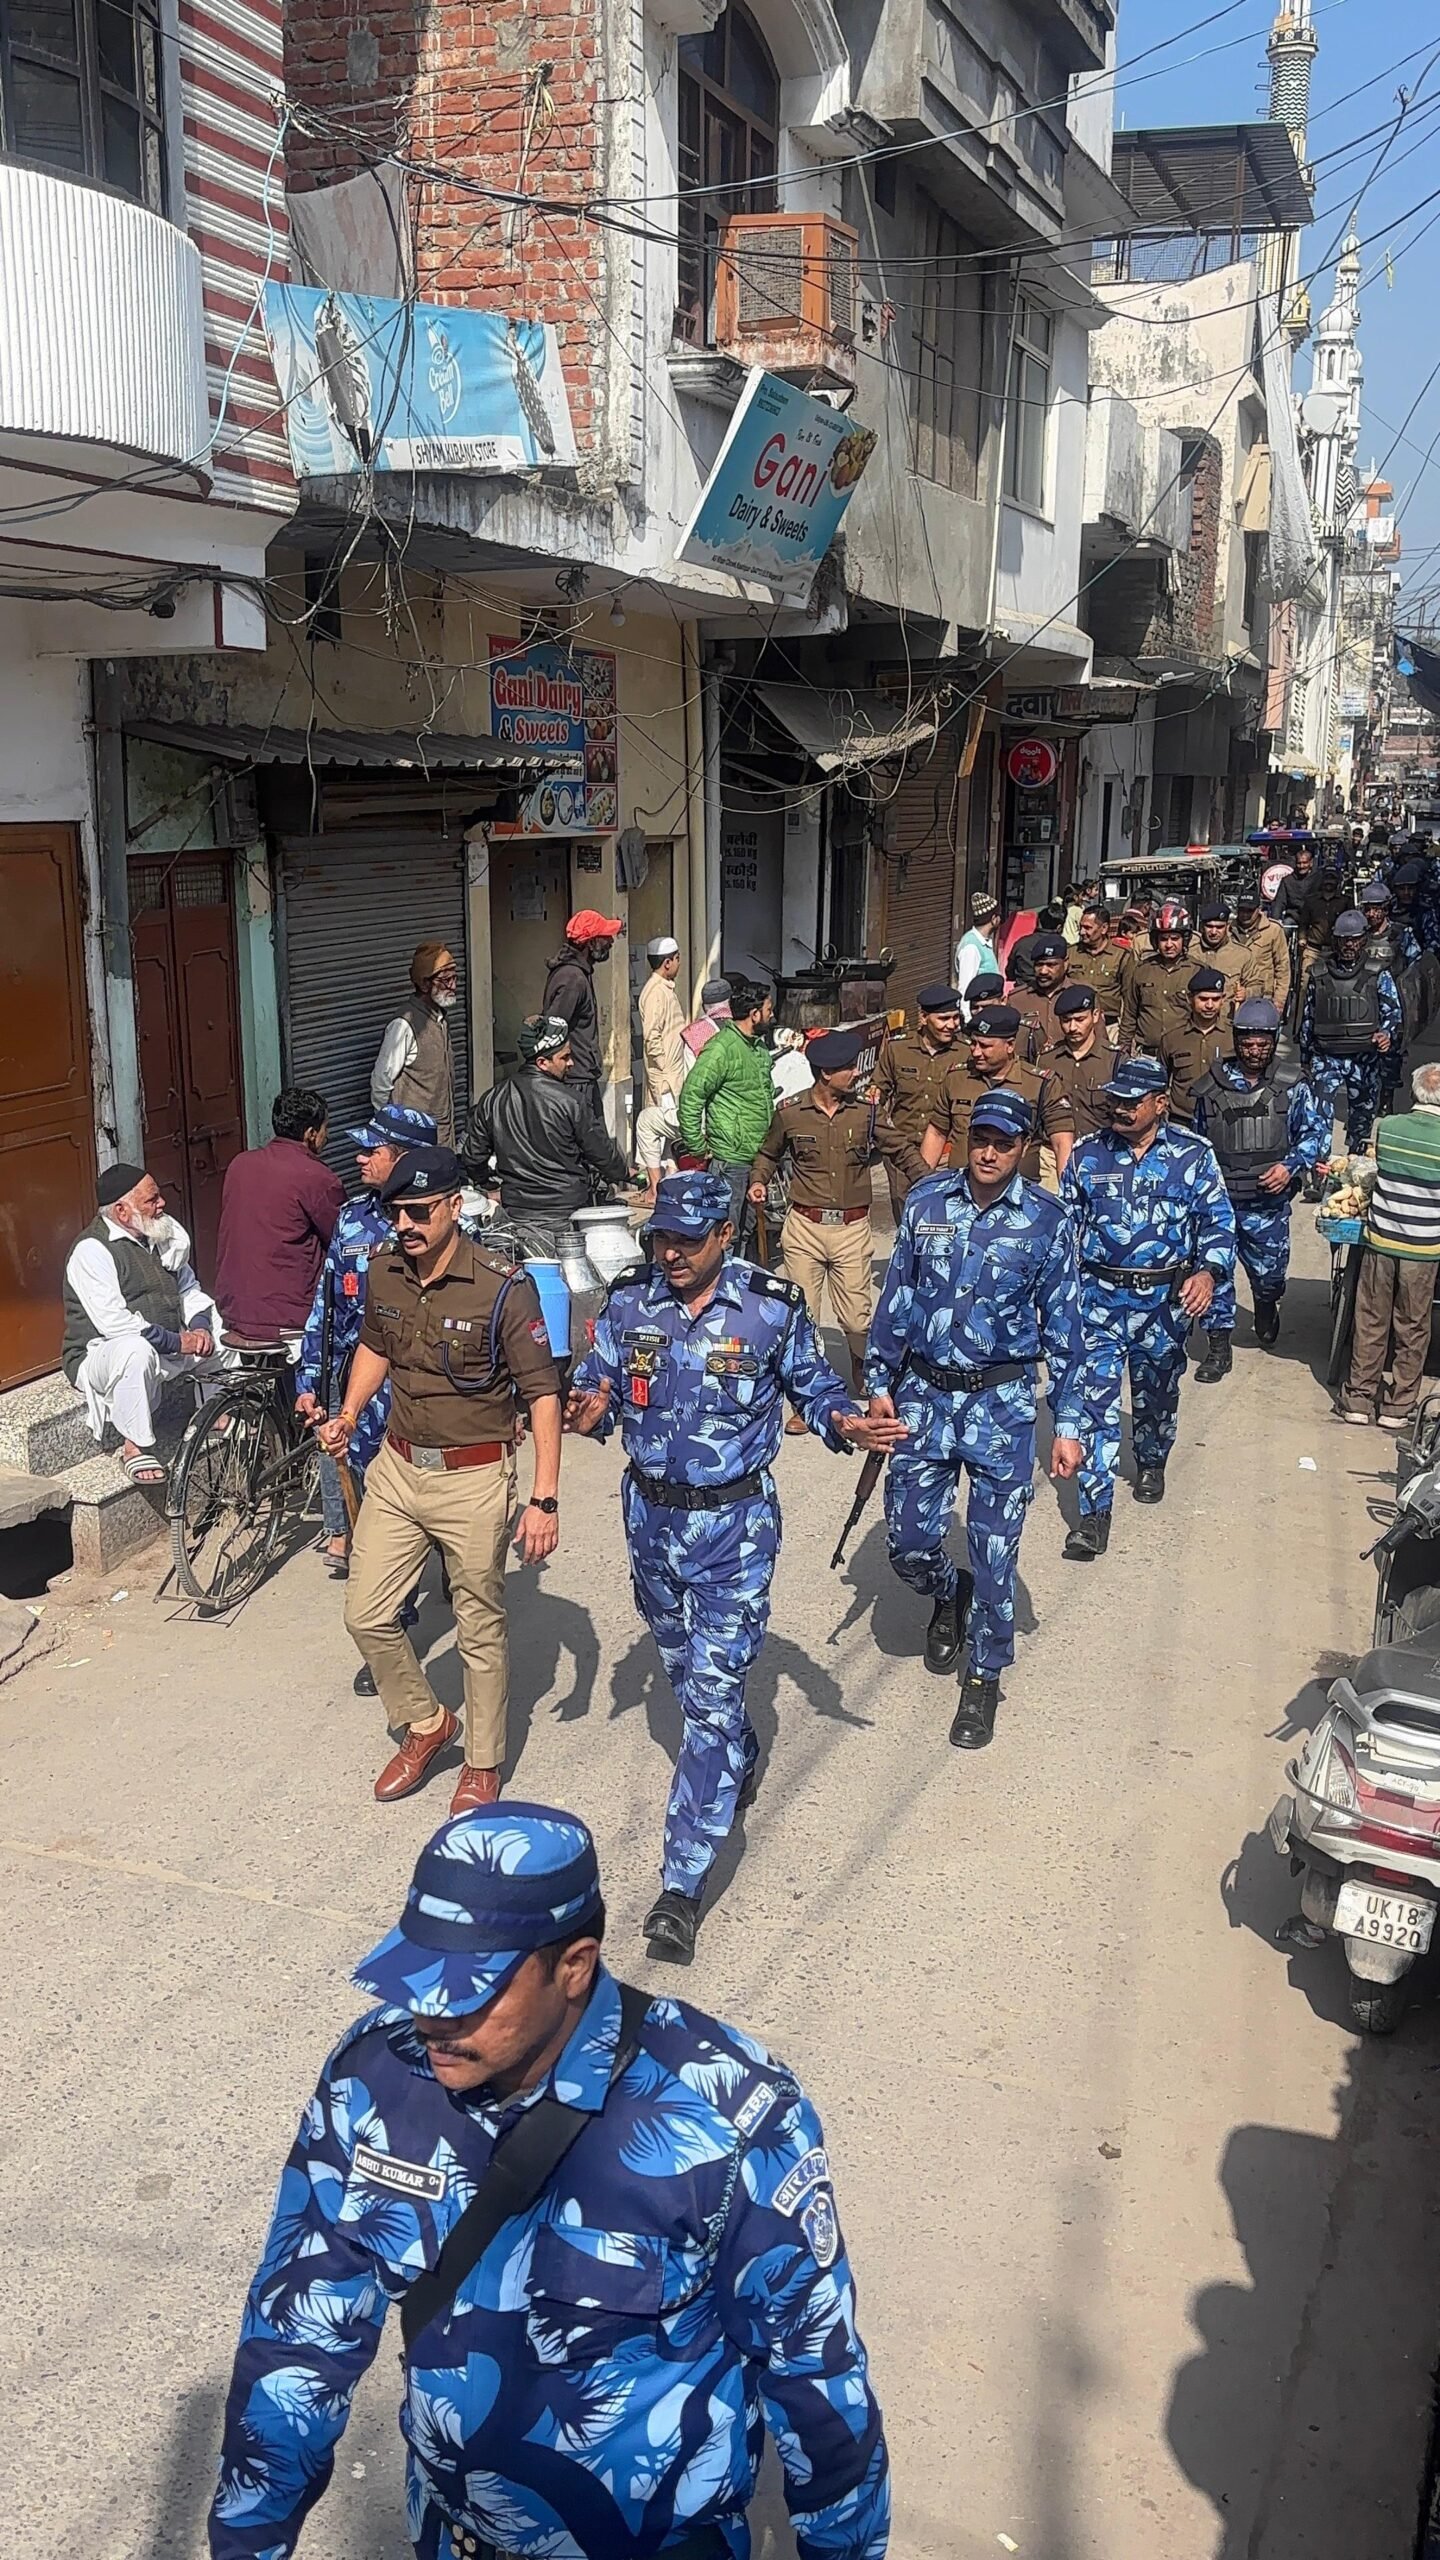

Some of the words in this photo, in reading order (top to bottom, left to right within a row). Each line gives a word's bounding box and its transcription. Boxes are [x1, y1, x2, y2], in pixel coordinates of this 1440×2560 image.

[429, 363, 454, 392] Cream
[439, 383, 454, 415] Bell
[416, 443, 446, 464] SHYAM
[445, 441, 478, 463] KIRANA
[475, 441, 498, 462] STORE
[754, 433, 834, 508] Gani
[728, 493, 762, 530] Dairy
[760, 505, 773, 529] &
[770, 509, 808, 542] Sweets
[494, 668, 534, 708] Gani
[535, 671, 581, 723] Dairy
[500, 716, 512, 741] &
[515, 717, 568, 743] Sweets
[1353, 1915, 1421, 1948] A9920
[356, 2154, 380, 2173] ASHU
[381, 2165, 425, 2188] KUMAR
